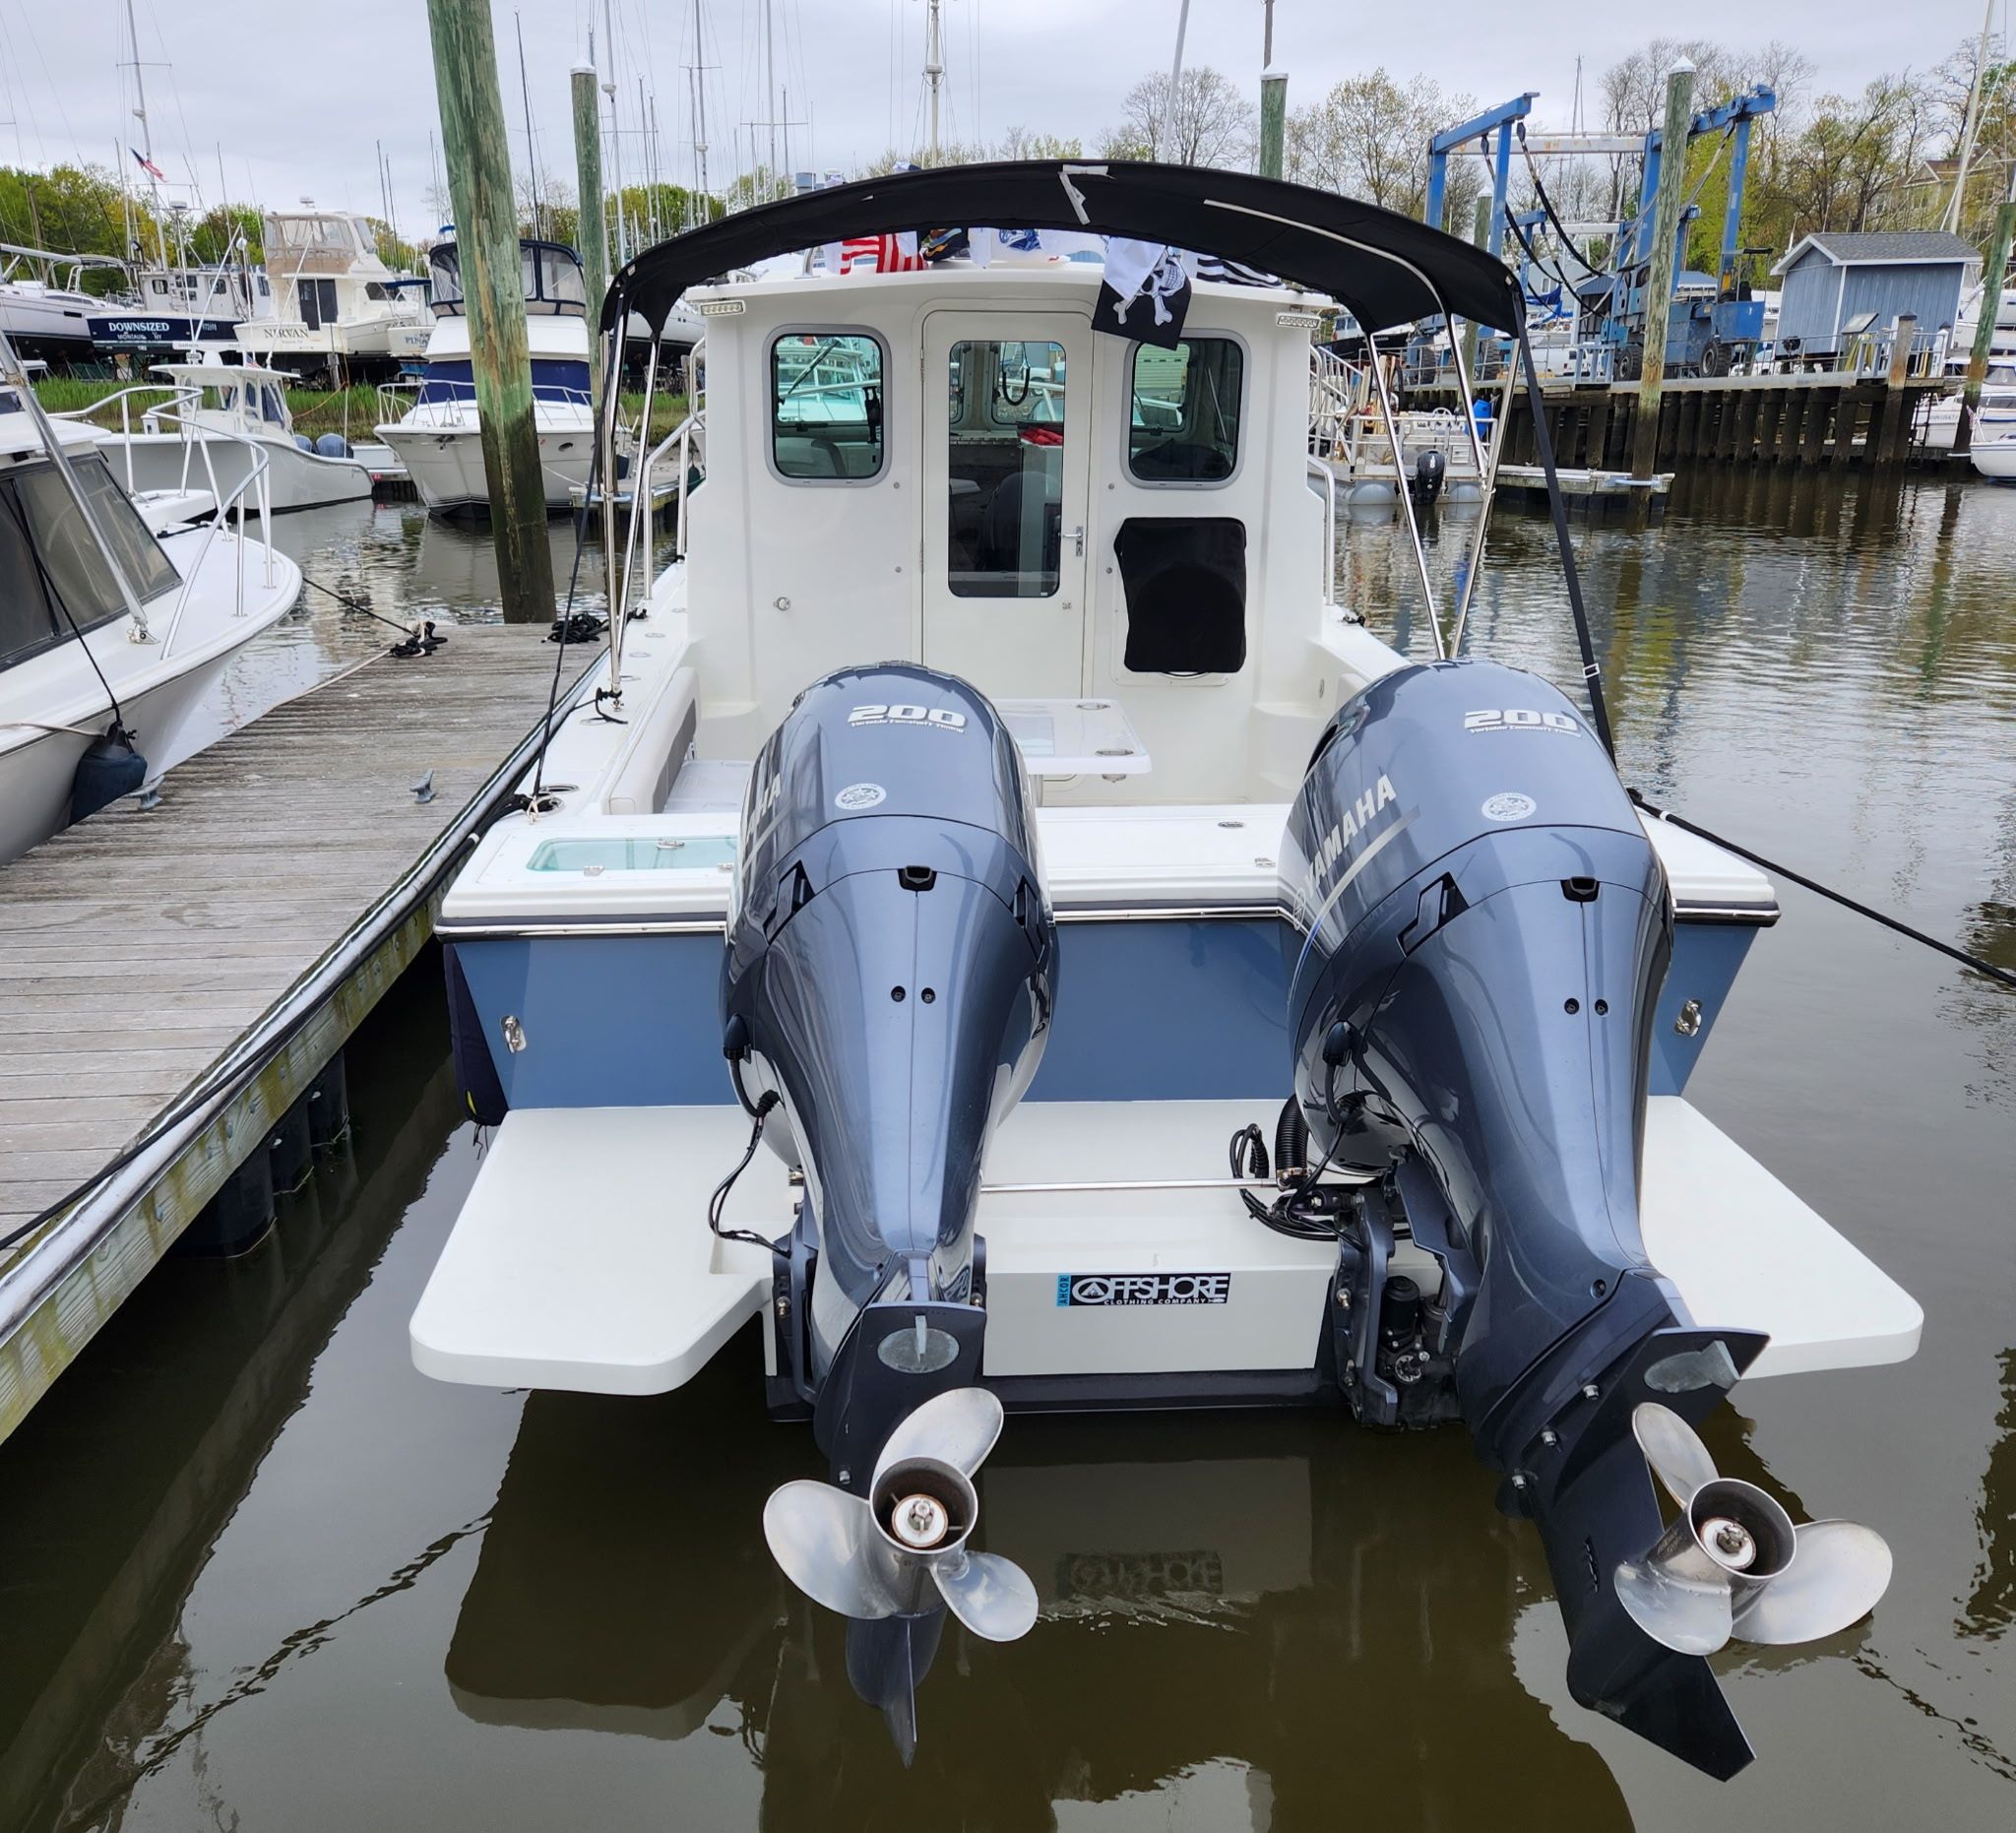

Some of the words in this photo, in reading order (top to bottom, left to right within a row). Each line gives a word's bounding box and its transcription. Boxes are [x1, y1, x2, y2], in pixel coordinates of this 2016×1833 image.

[108, 322, 169, 332] DOWNSIZED
[848, 705, 966, 727] 200
[1465, 709, 1579, 731] 200
[1303, 774, 1397, 899] YAMAHA
[1072, 1276, 1228, 1303] OFFSHORE
